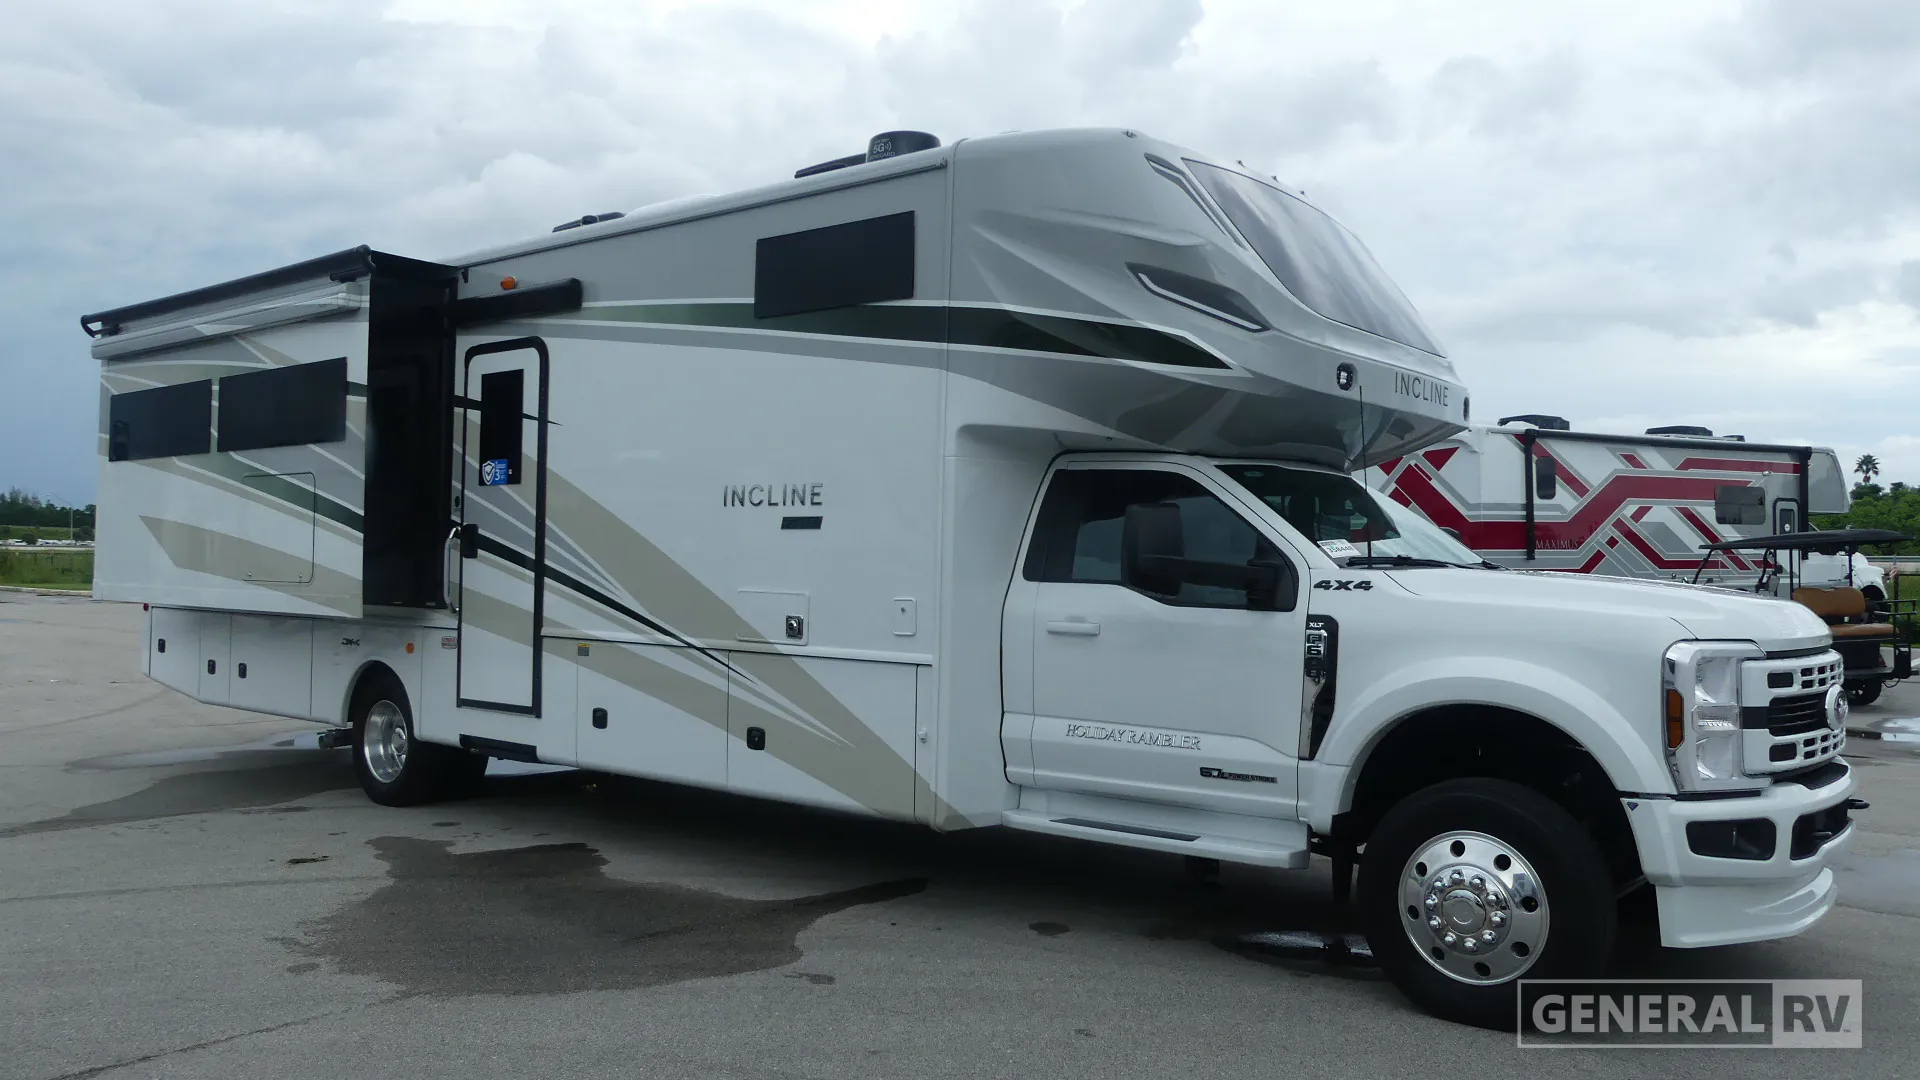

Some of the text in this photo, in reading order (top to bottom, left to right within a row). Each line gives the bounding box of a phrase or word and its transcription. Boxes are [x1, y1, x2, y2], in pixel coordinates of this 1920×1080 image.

[873, 143, 885, 154] 5G
[1394, 370, 1449, 407] INCLINE
[723, 482, 824, 507] INCLINE
[1536, 540, 1579, 550] MAXIMUS
[1313, 580, 1374, 591] 4X4
[1066, 724, 1202, 750] HOLIDAY RAMBLER
